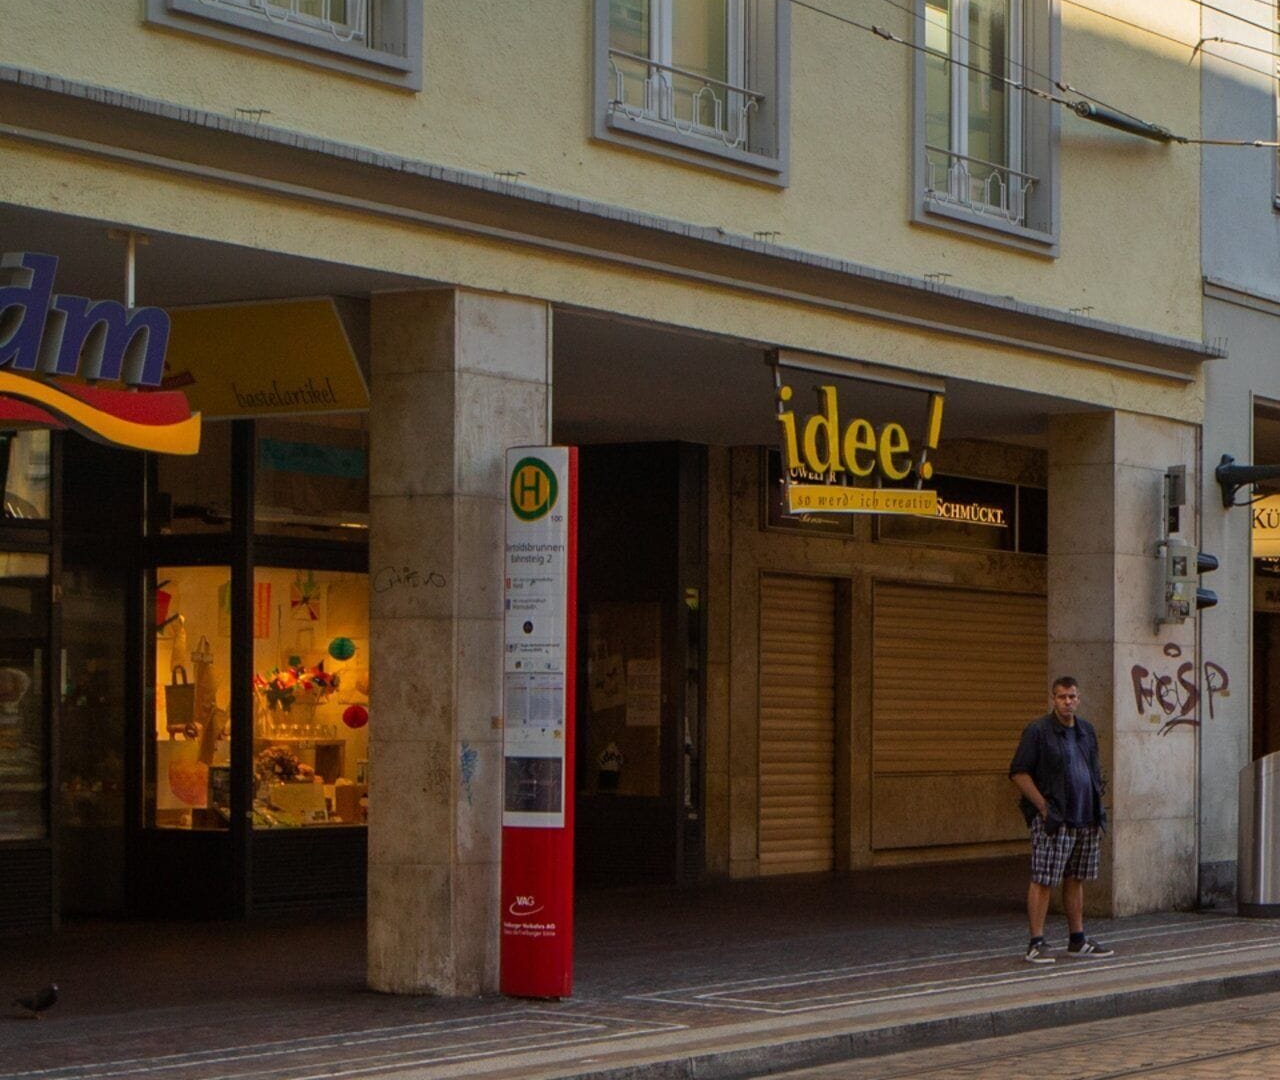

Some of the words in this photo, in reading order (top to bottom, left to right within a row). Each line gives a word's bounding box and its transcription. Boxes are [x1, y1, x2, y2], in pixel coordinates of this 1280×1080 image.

[0, 252, 171, 387] dm
[233, 377, 338, 408] bastelartikel
[778, 385, 945, 481] idee!
[520, 471, 540, 507] H
[797, 495, 812, 506] so
[860, 491, 879, 509] ich
[885, 495, 935, 510] creativ
[547, 554, 553, 563] 2
[515, 896, 535, 906] VAG
